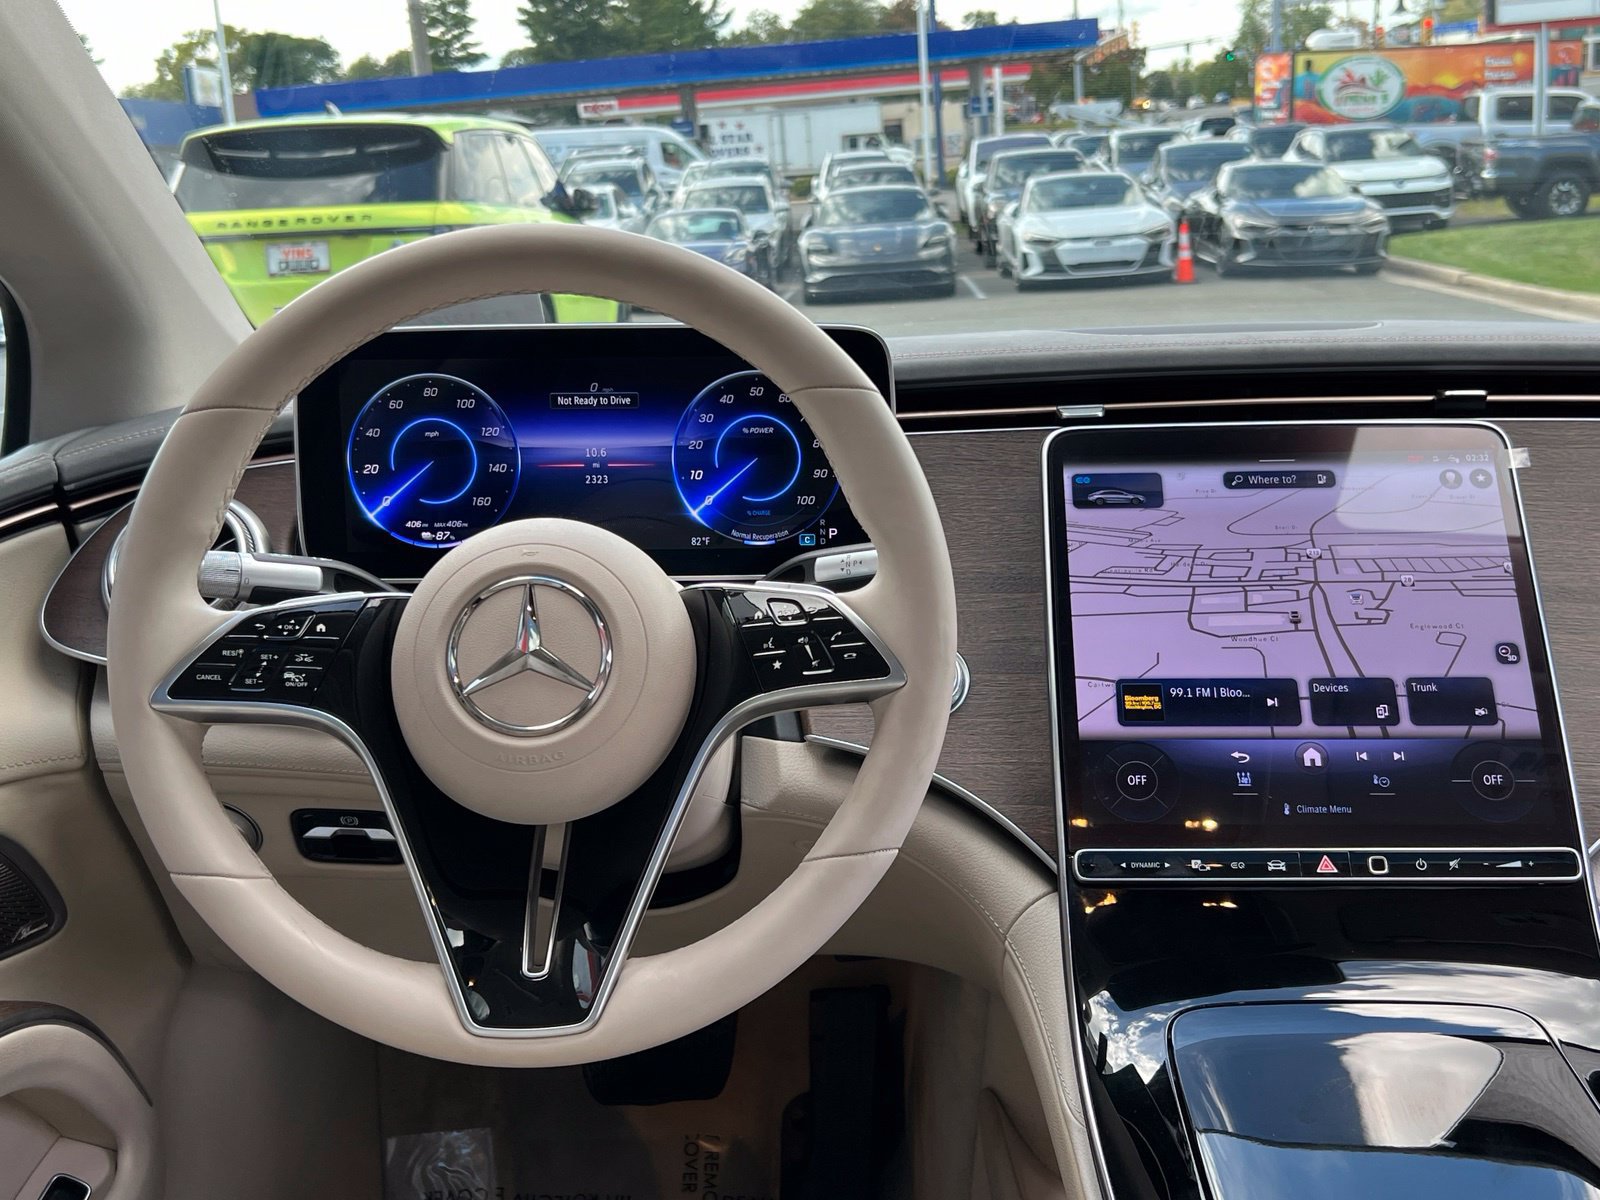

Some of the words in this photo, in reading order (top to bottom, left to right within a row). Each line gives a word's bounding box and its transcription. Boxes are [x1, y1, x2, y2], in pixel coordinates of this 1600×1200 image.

[217, 219, 289, 229] RANGE
[296, 215, 372, 225] ROVER
[423, 387, 438, 398] 80
[590, 383, 598, 392] 0
[749, 386, 764, 397] 50
[456, 398, 475, 409] 100
[557, 396, 572, 405] Not
[573, 396, 598, 407] Ready
[600, 396, 608, 405] to
[610, 396, 631, 405] Drive
[719, 394, 734, 404] 40
[388, 399, 404, 410] 60
[698, 413, 714, 423] 30
[365, 428, 381, 438] 40
[424, 430, 440, 438] mph
[481, 426, 500, 437] 120
[688, 440, 703, 450] 20
[585, 448, 607, 458] 10.6
[363, 465, 379, 475] 20
[488, 463, 508, 474] 140
[813, 468, 828, 479] 90
[585, 475, 608, 484] 2323
[690, 470, 703, 480] 10
[1248, 475, 1279, 485] Where
[1281, 474, 1297, 485] to?
[472, 496, 492, 506] 160
[796, 495, 816, 506] 100
[405, 520, 421, 528] 406
[820, 519, 826, 527] R
[731, 528, 752, 540] Normal
[752, 529, 789, 540] Recuperation
[820, 528, 826, 536] N
[828, 528, 838, 539] P
[691, 537, 710, 547] 82°F
[283, 623, 294, 631] OK
[1169, 687, 1193, 698] 99.1
[1196, 687, 1211, 698] FM
[1313, 683, 1349, 693] Devices
[1411, 683, 1438, 692] Trunk
[1127, 775, 1147, 786] OFF
[1483, 775, 1504, 786] OFF
[1296, 805, 1327, 814] Climate
[1329, 805, 1352, 814] Menu
[682, 1134, 700, 1193] OVER
